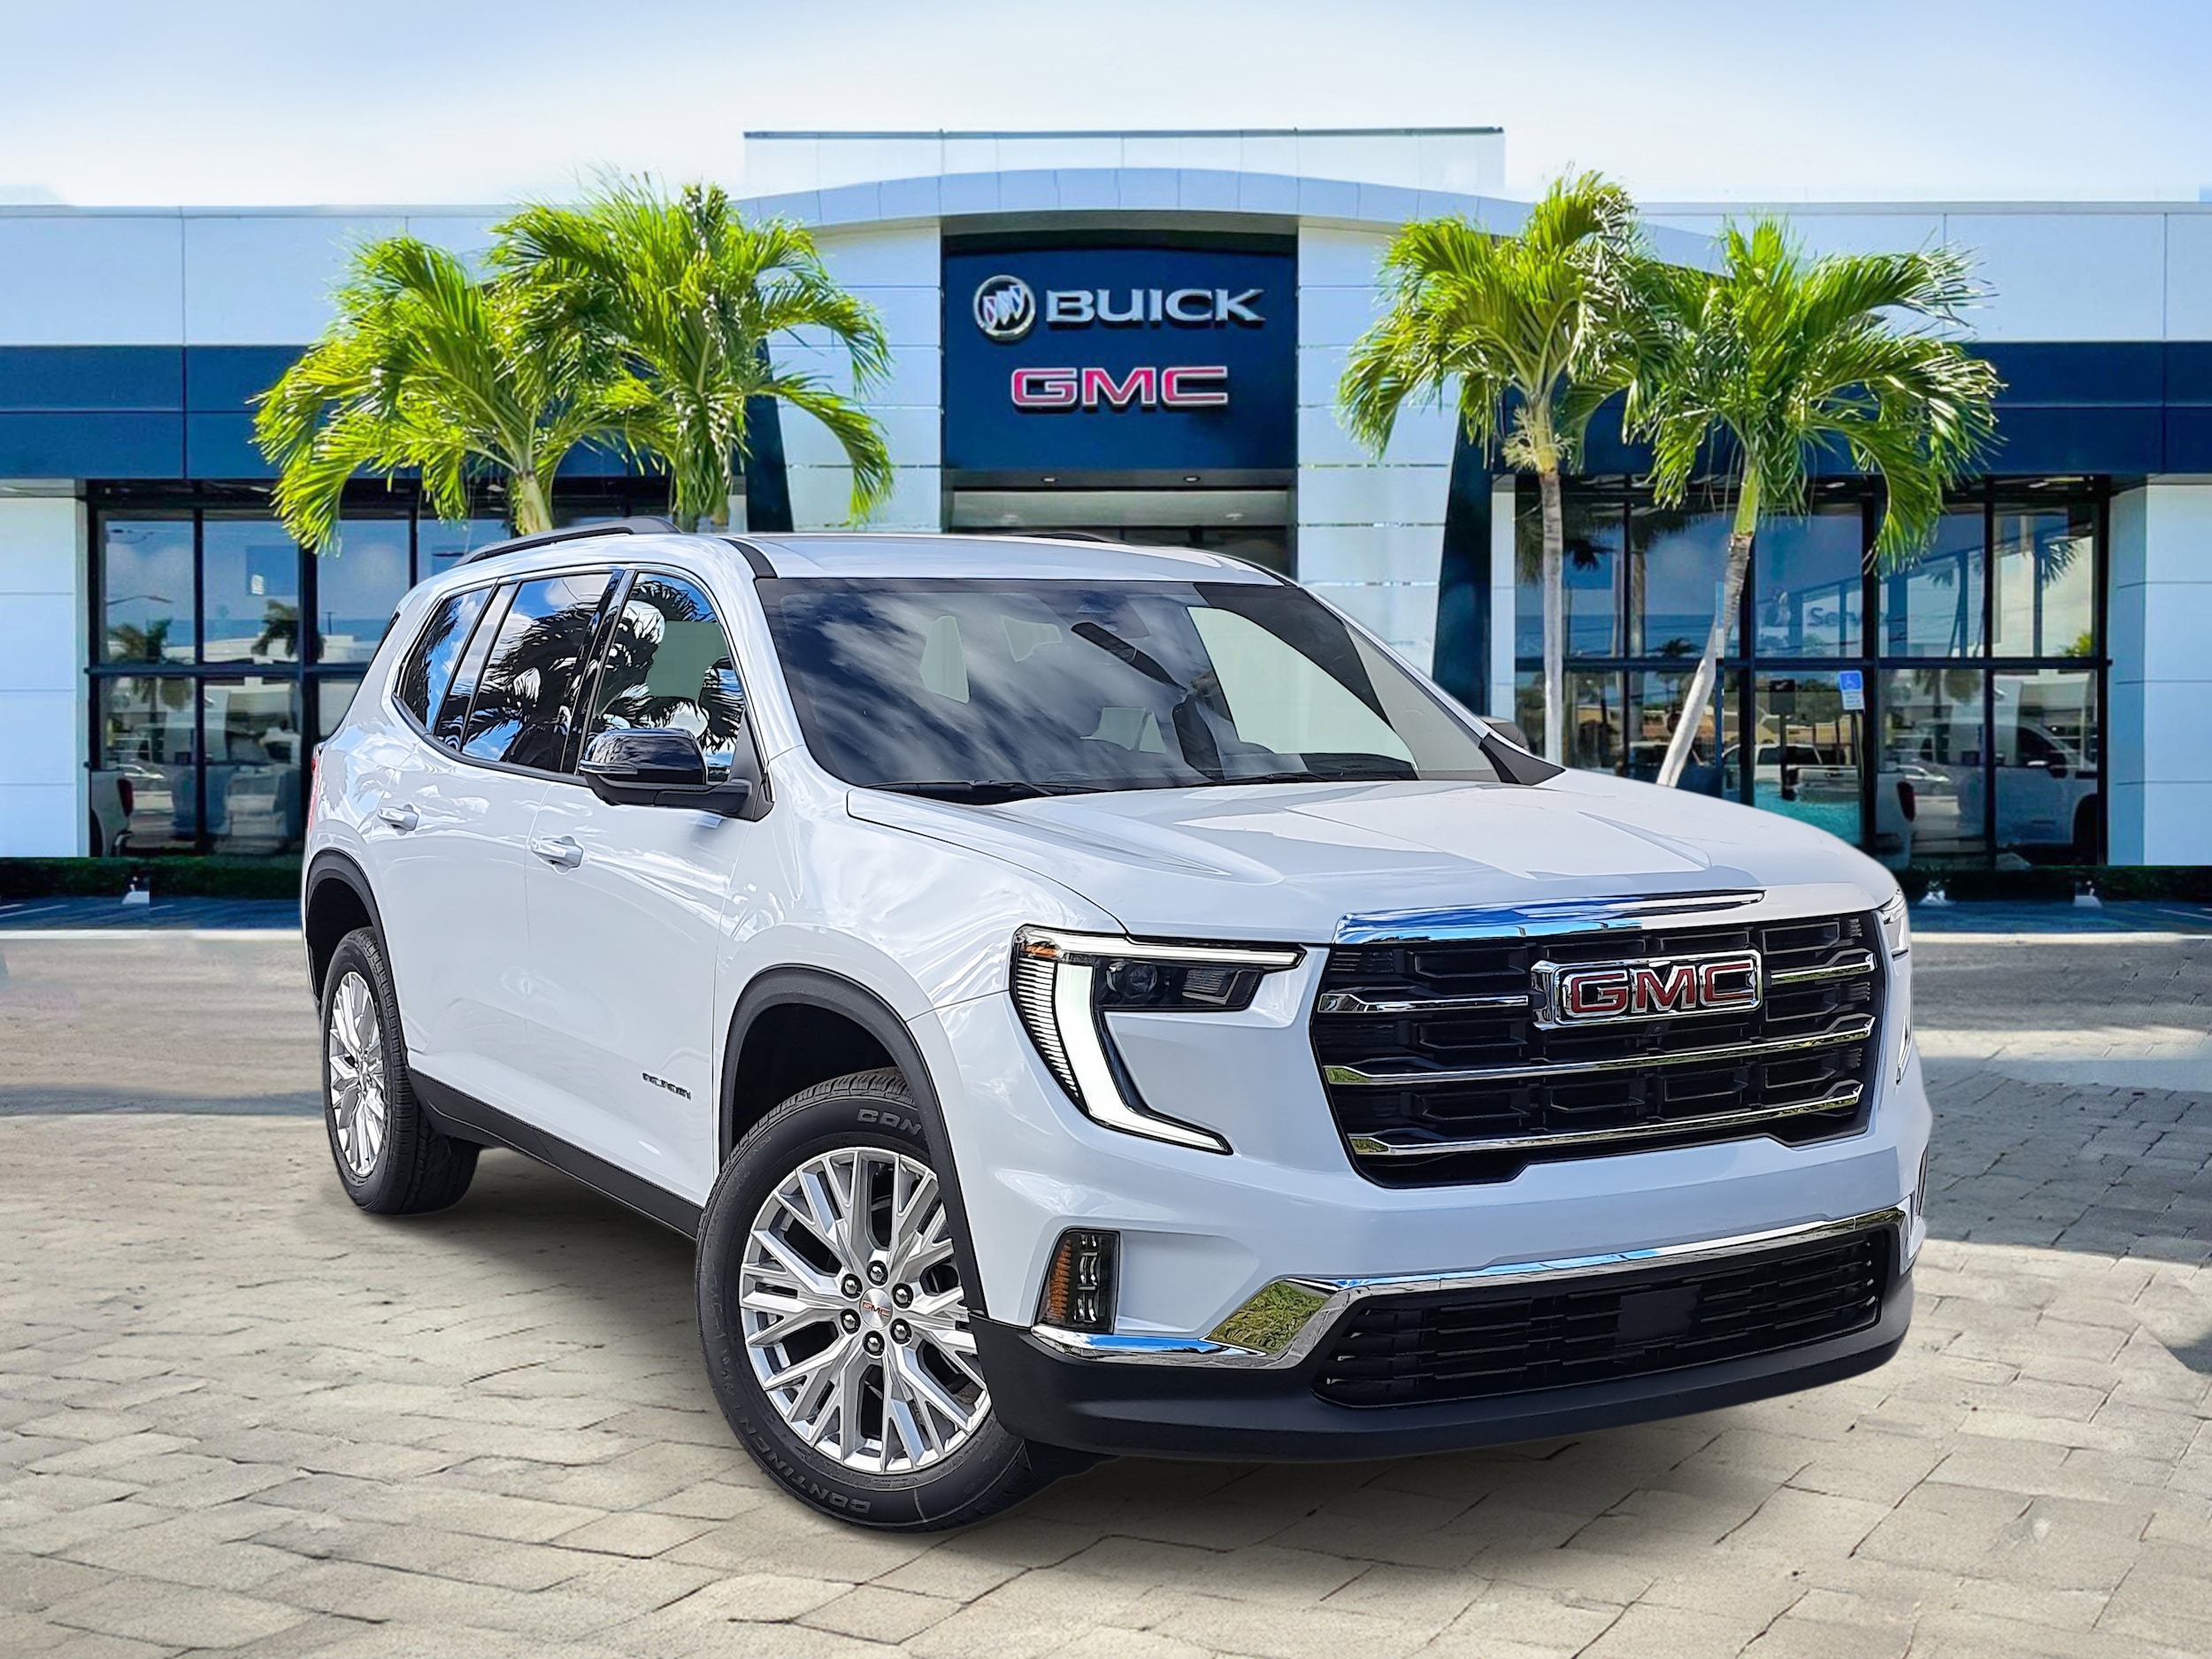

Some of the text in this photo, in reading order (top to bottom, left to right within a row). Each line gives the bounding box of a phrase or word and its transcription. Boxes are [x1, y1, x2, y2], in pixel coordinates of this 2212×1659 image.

[1046, 288, 1264, 322] BUICK
[1011, 365, 1228, 406] GMC
[1562, 959, 1755, 1018] GMC
